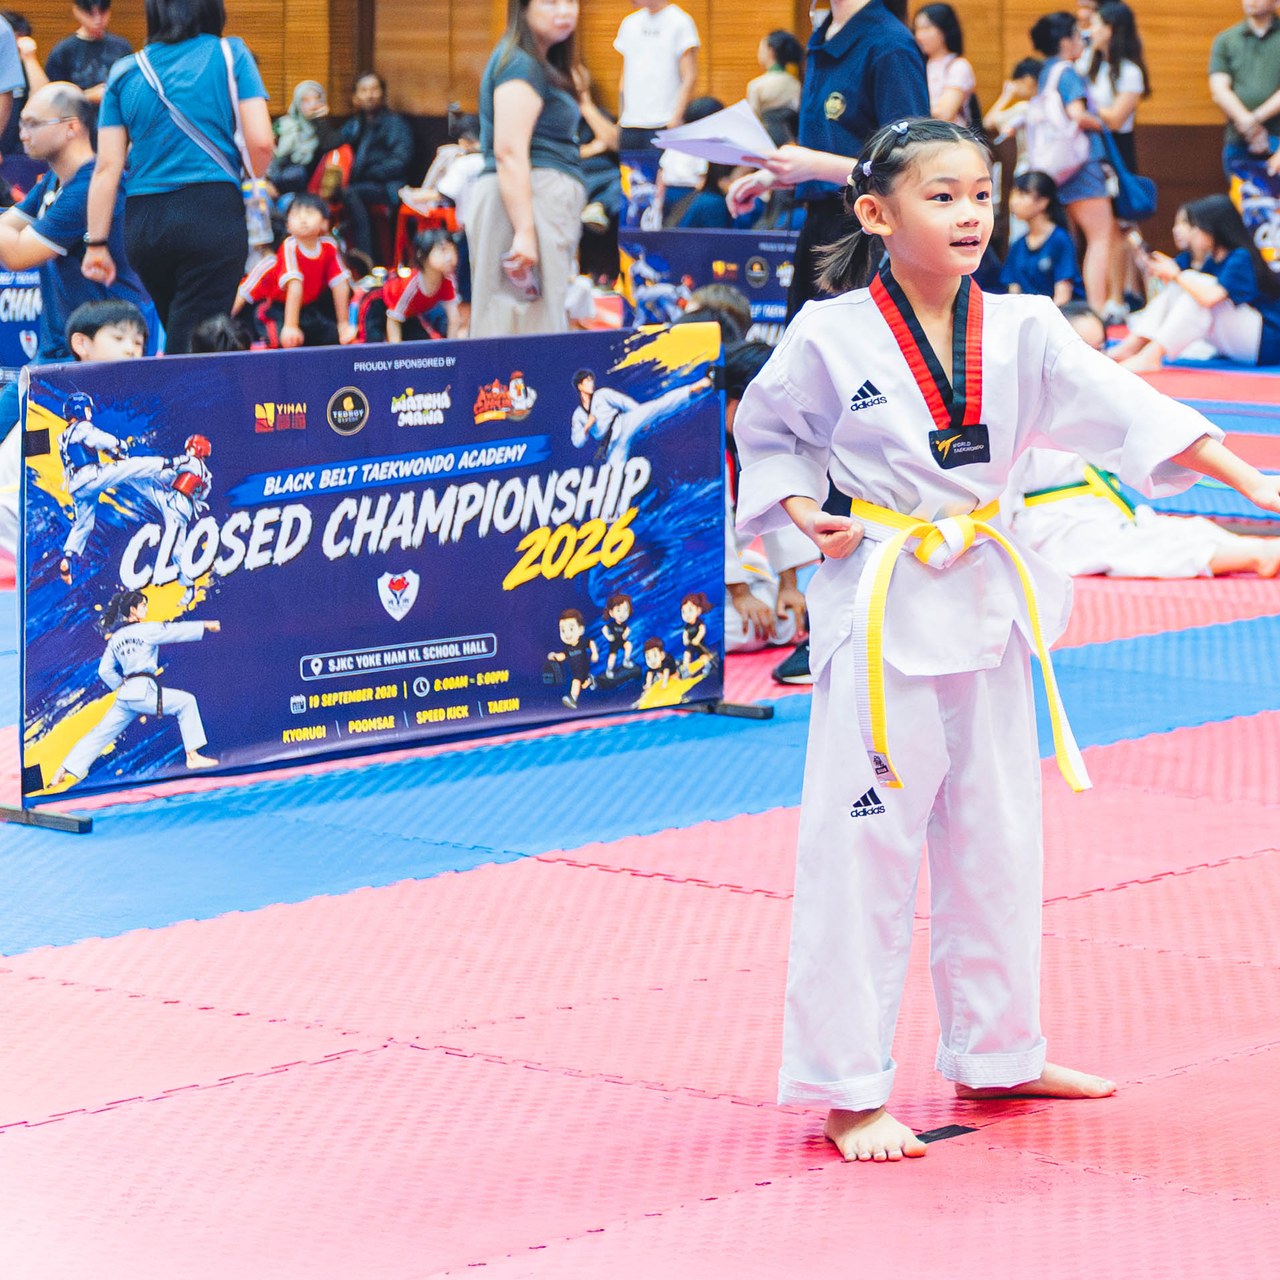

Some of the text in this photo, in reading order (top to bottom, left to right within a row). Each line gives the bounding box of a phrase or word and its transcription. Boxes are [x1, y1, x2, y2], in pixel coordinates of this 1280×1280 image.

[354, 356, 456, 372] PROUDLY SPONSORED BY
[276, 402, 307, 416] YIHAI
[391, 390, 451, 414] MATCHA
[850, 396, 887, 411] adidas
[953, 441, 971, 449] WORLD
[954, 444, 985, 454] TAEKWONDO
[263, 443, 527, 496] BLACK BELT TAEKWONDO ACADEMY
[119, 456, 652, 592] CLOSED CHAMPIONSHIP
[502, 507, 639, 591] 2026
[328, 640, 487, 672] SJKC YOKE NAM KL SCHOOL HALL
[321, 687, 373, 707] SEPTEMBER
[282, 725, 326, 744] KYORUGI
[348, 715, 395, 734] POOMSAE
[416, 707, 446, 724] SPEED
[447, 705, 470, 720] KICK
[850, 805, 886, 818] adidas
